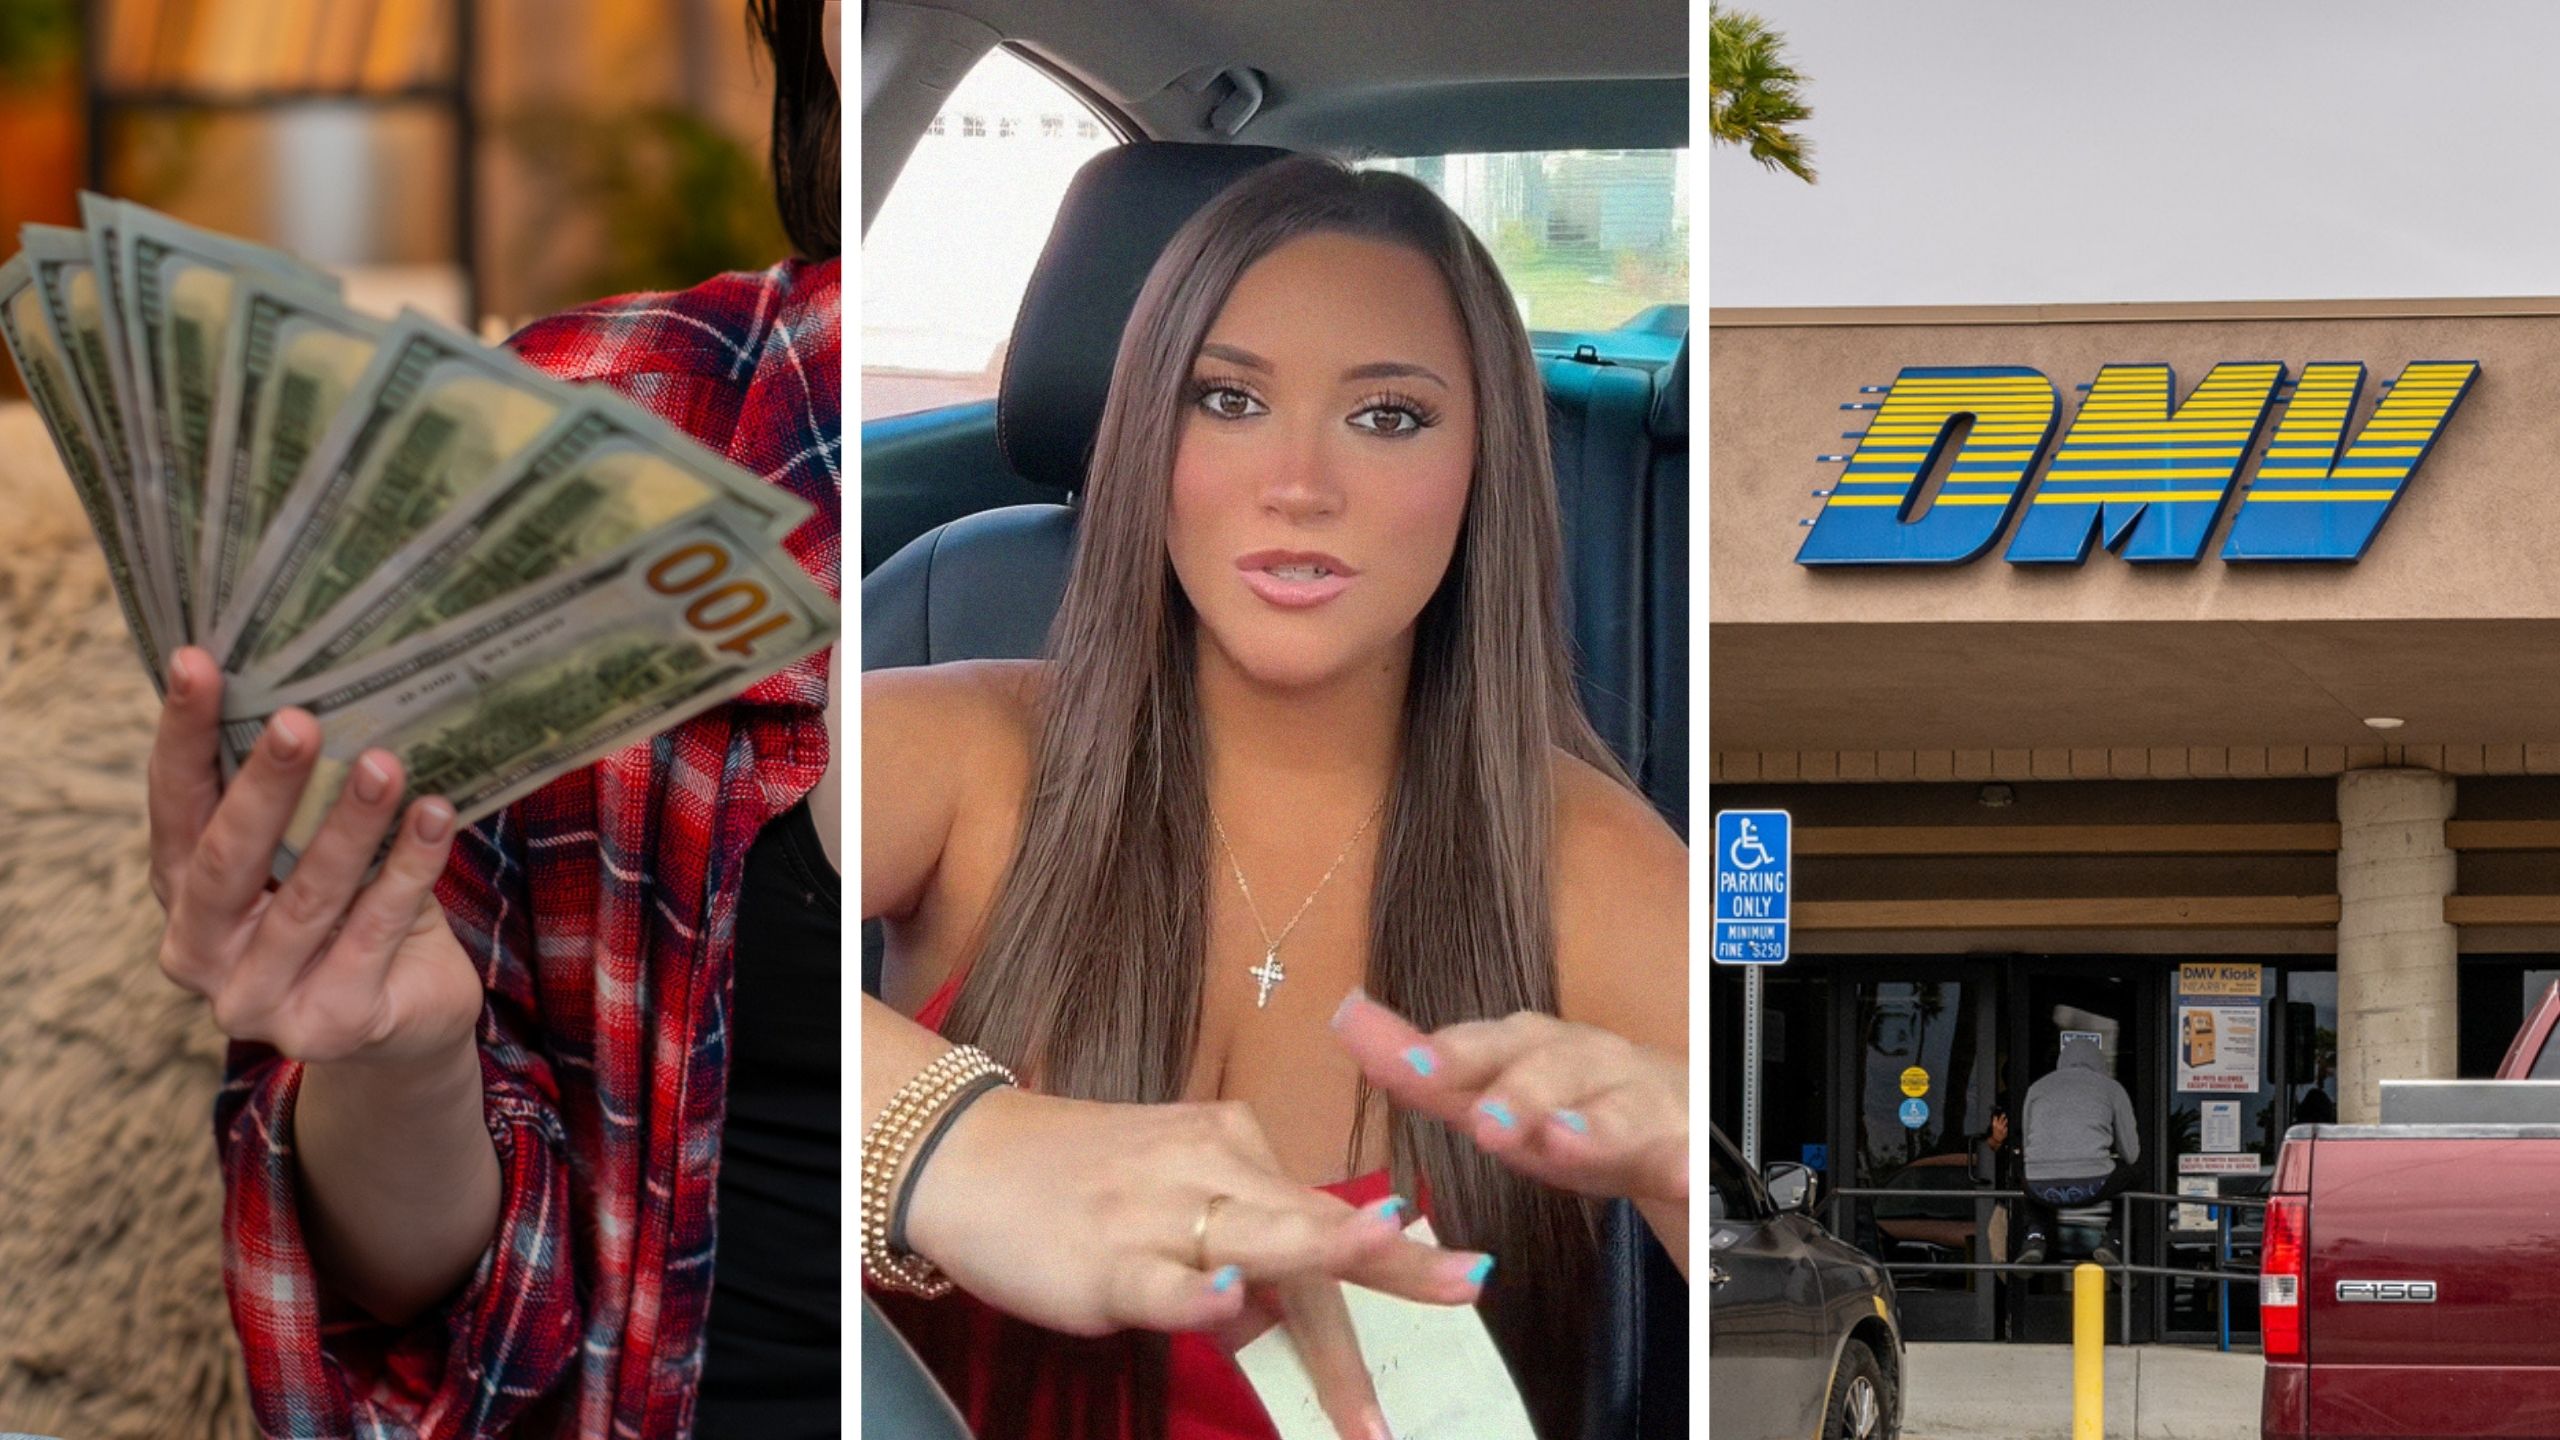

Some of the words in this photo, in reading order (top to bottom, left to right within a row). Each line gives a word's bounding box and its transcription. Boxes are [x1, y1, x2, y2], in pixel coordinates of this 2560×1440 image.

[1795, 360, 2480, 568] DMV
[645, 541, 792, 658] 100
[1720, 871, 1784, 893] PARKING
[1732, 895, 1772, 917] ONLY
[1728, 925, 1775, 940] MINIMUM
[1719, 942, 1744, 958] FINE
[1751, 942, 1782, 958] $250
[2183, 967, 2216, 979] DMV
[2221, 967, 2257, 980] Kiosk
[2182, 981, 2228, 992] NEARBY
